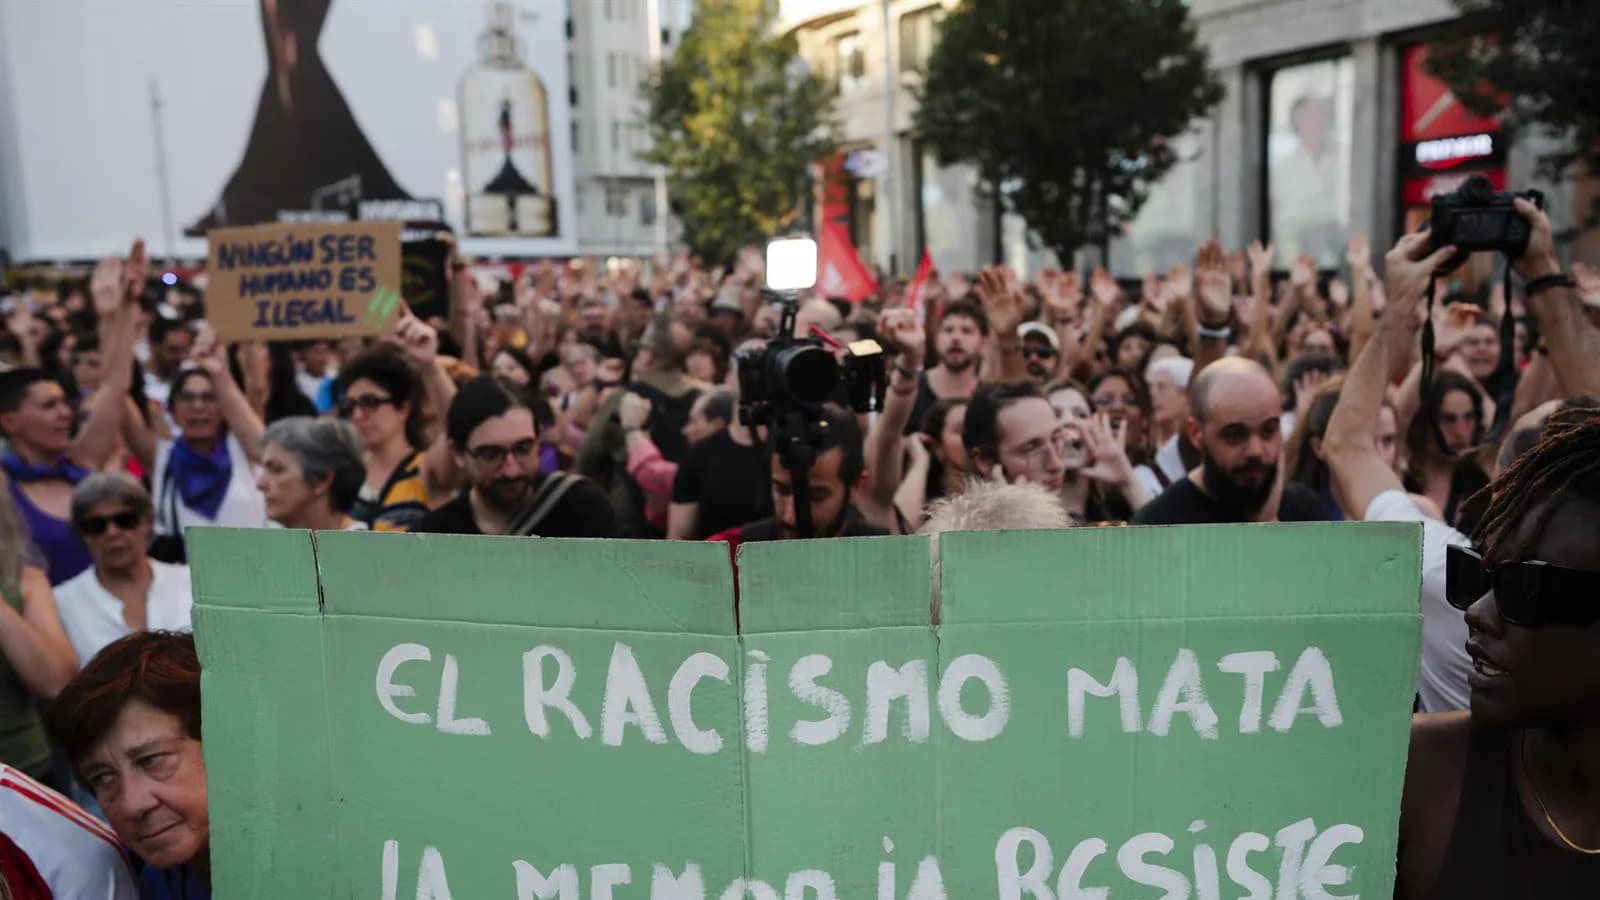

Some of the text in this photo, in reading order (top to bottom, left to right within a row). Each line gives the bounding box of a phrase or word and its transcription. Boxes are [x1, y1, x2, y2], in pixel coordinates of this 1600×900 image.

[319, 233, 377, 265] SER
[239, 269, 333, 298] HUMANO
[338, 266, 377, 293] ES
[254, 298, 356, 328] ILEGAL
[376, 643, 492, 736] EL
[1067, 646, 1344, 740] MATA
